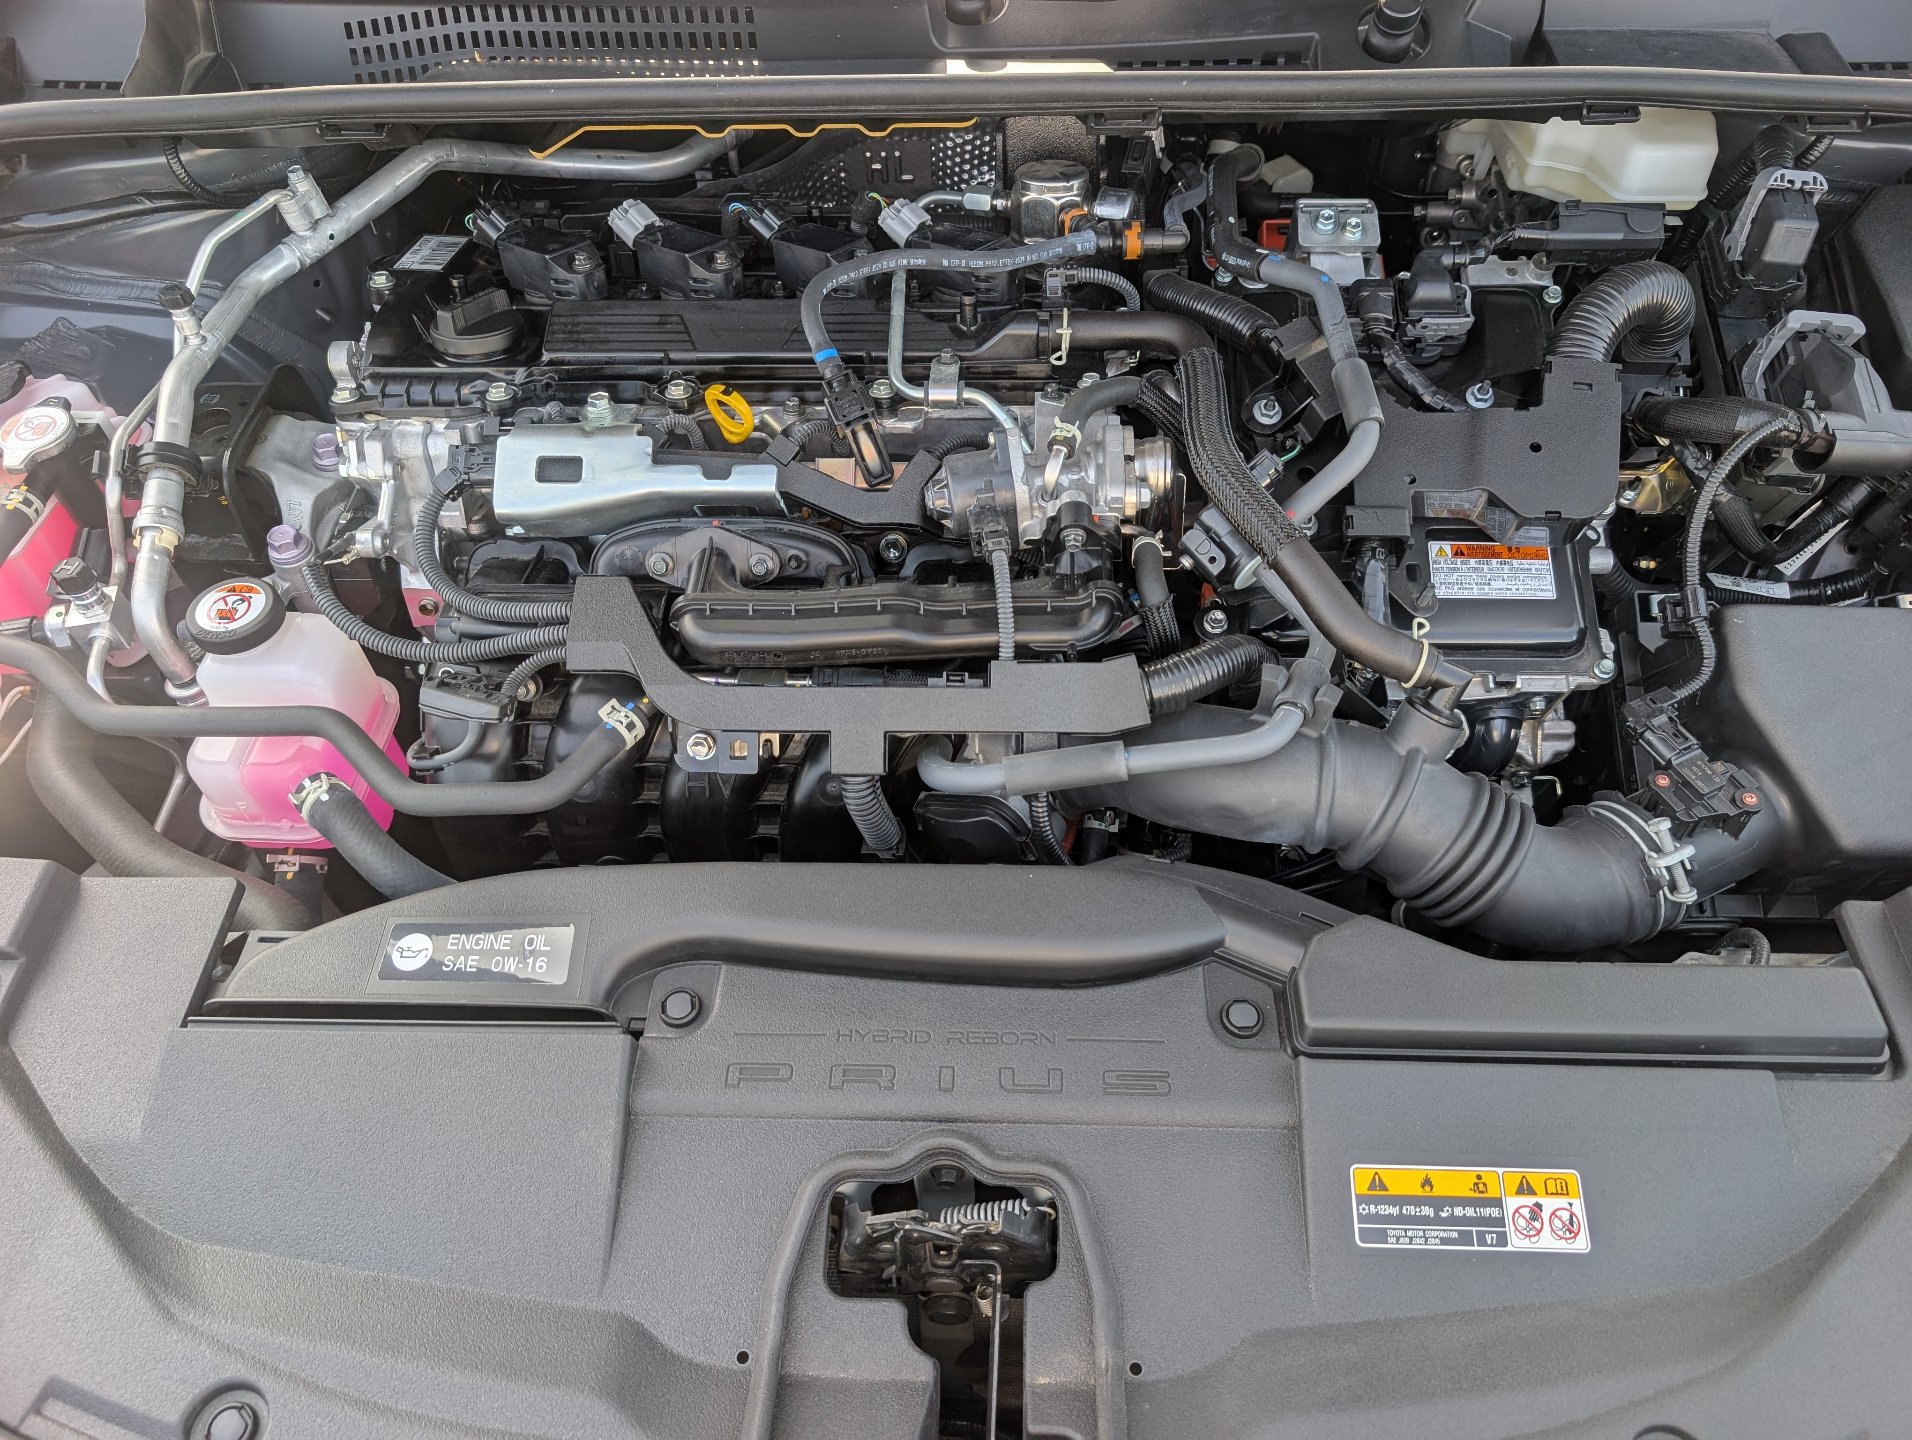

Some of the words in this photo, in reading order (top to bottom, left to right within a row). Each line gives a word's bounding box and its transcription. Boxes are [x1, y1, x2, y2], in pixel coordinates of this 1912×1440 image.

[54, 559, 80, 576] H
[195, 629, 237, 639] DENSO
[447, 933, 513, 950] ENGINE
[524, 934, 551, 951] OIL
[442, 955, 480, 972] SAE
[491, 956, 548, 973] 0W-16
[834, 1028, 933, 1044] HYBRID
[946, 1029, 1058, 1046] REBORN
[724, 1061, 1172, 1097] PRIUS
[1402, 1205, 1435, 1218] 470±30g
[1386, 1229, 1405, 1237] TOYOTA
[1406, 1229, 1424, 1238] MOTOR
[1425, 1230, 1459, 1238] CORPORATION
[1485, 1233, 1497, 1245] V7
